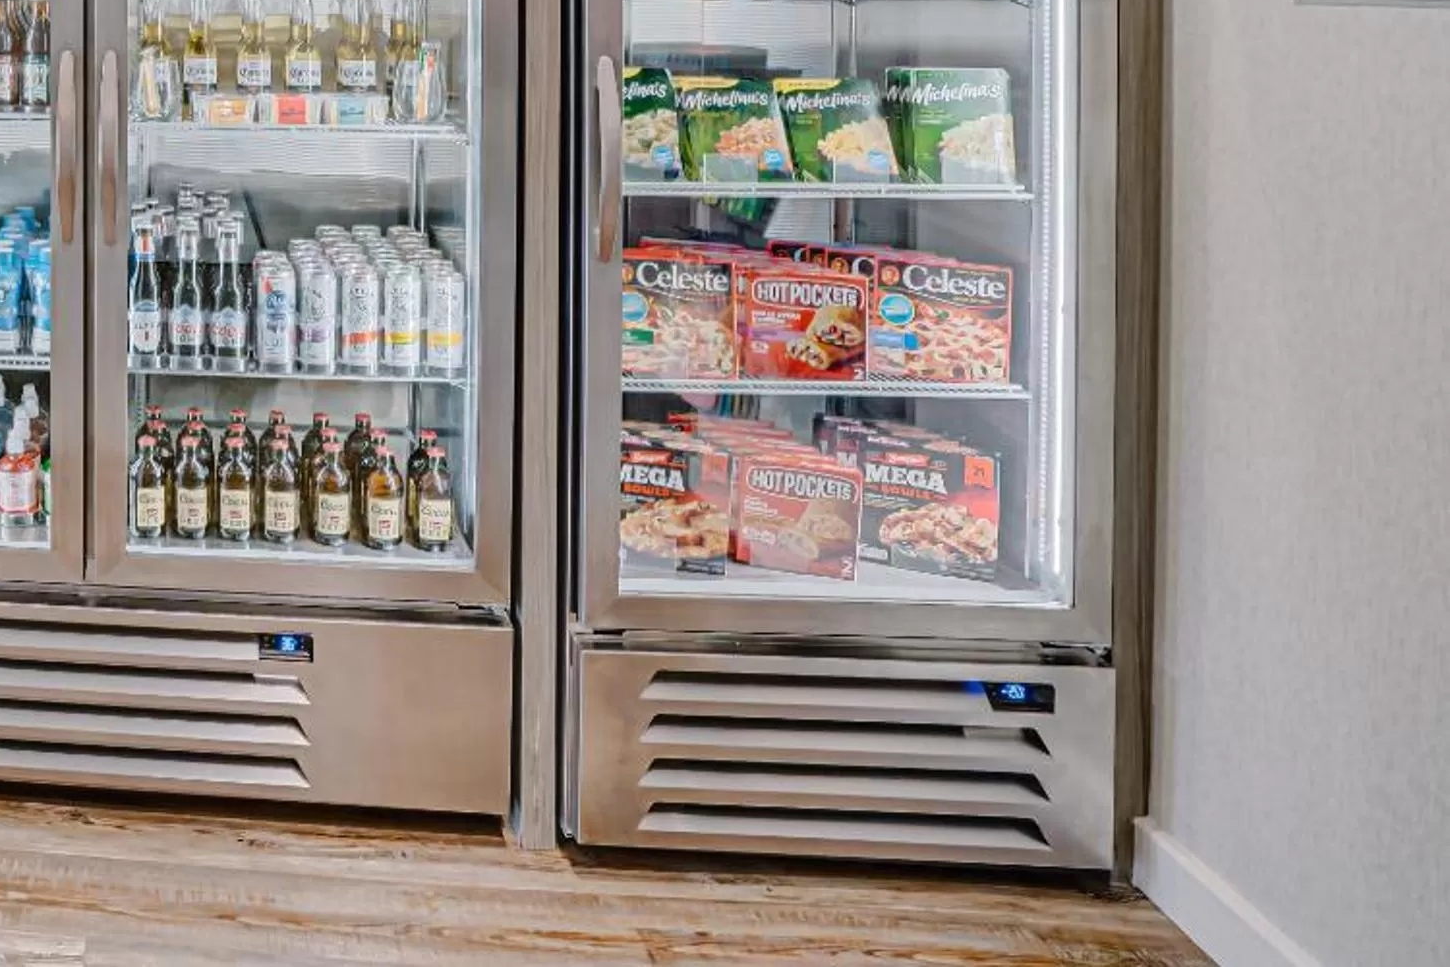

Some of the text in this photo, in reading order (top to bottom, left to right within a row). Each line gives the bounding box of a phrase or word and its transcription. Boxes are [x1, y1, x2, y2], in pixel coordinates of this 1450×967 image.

[622, 81, 667, 100] elina's
[683, 91, 768, 110] Michelina's
[787, 92, 871, 113] Michelina's
[912, 82, 1001, 106] Michelina's
[636, 262, 729, 291] Celeste
[902, 265, 1006, 299] Celeste
[757, 282, 858, 307] HOT POCKETS
[752, 470, 852, 501] HOT POCKETS
[865, 462, 948, 495] MEGA
[841, 559, 854, 575] 2
